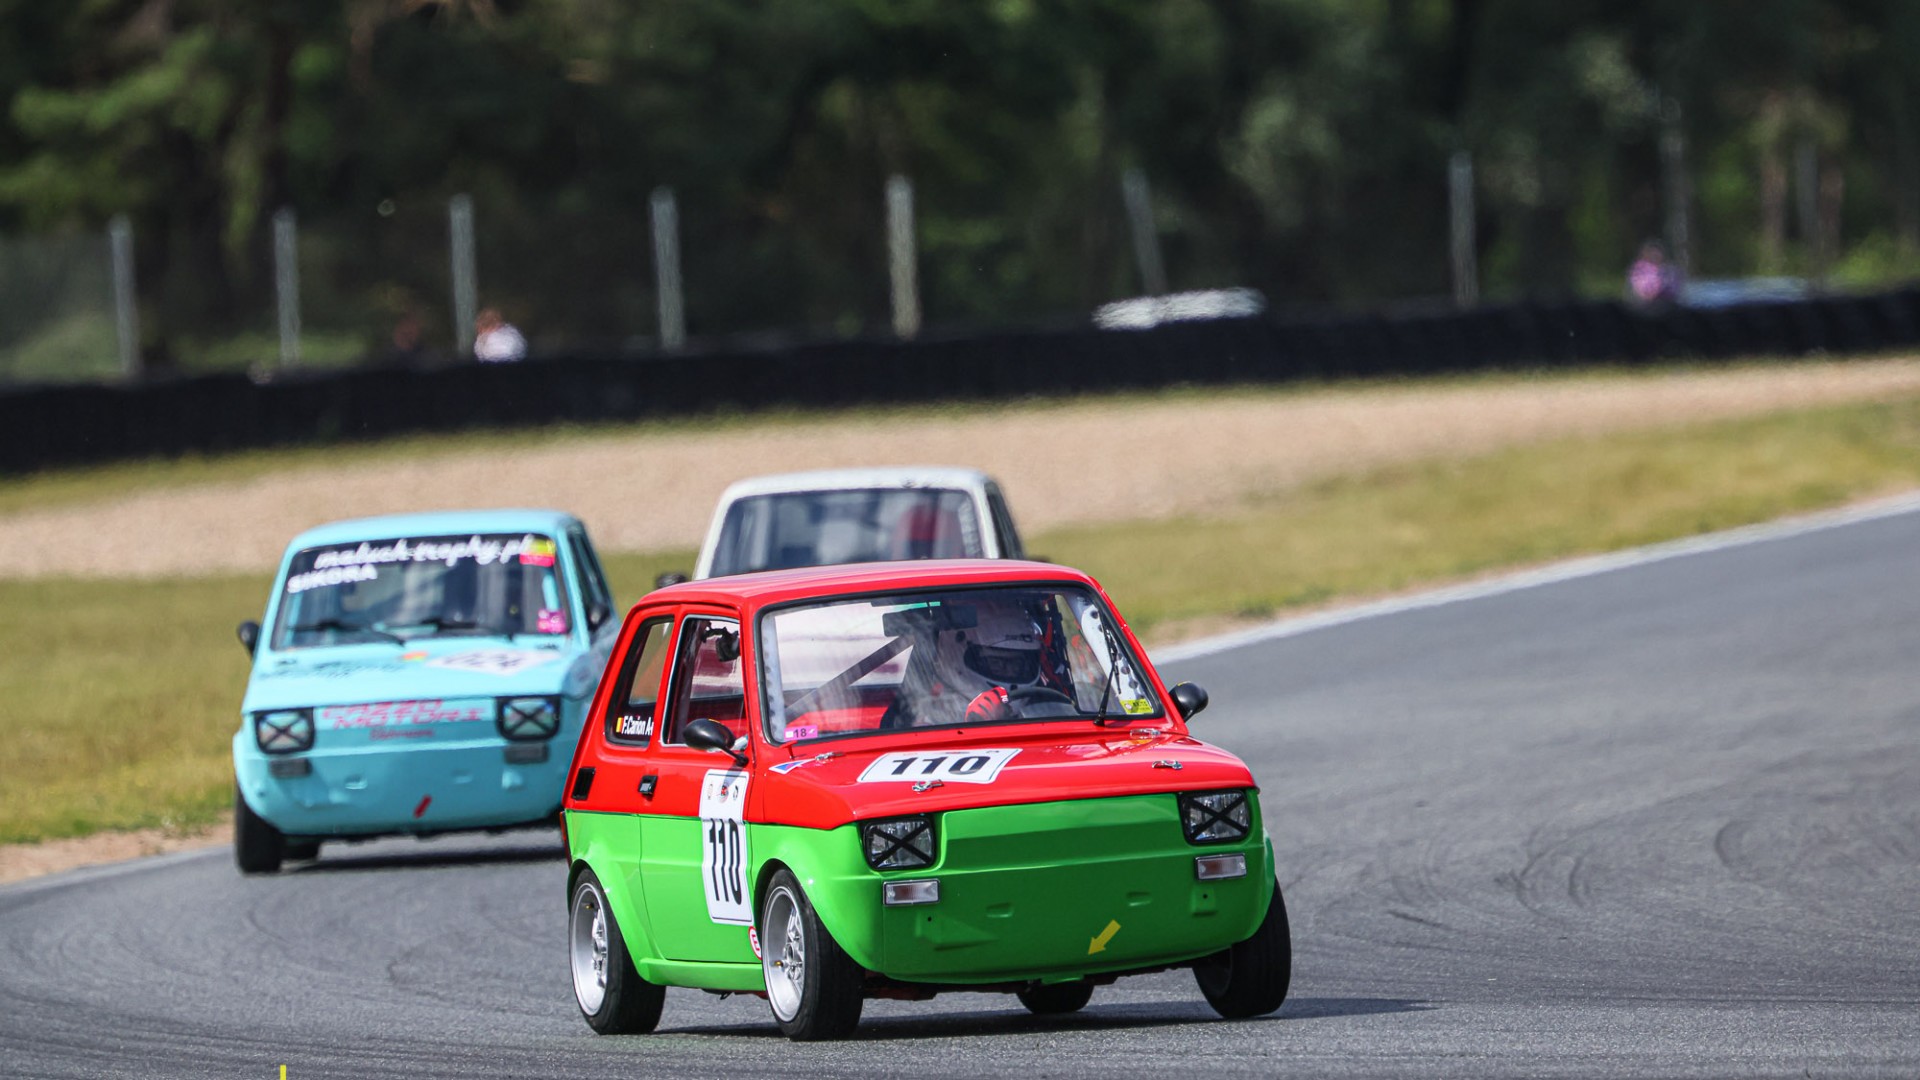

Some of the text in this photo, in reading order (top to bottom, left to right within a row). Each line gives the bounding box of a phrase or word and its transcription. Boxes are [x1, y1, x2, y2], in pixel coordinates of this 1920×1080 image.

[793, 728, 807, 738] 18
[891, 755, 992, 776] 110
[709, 818, 742, 905] 110
